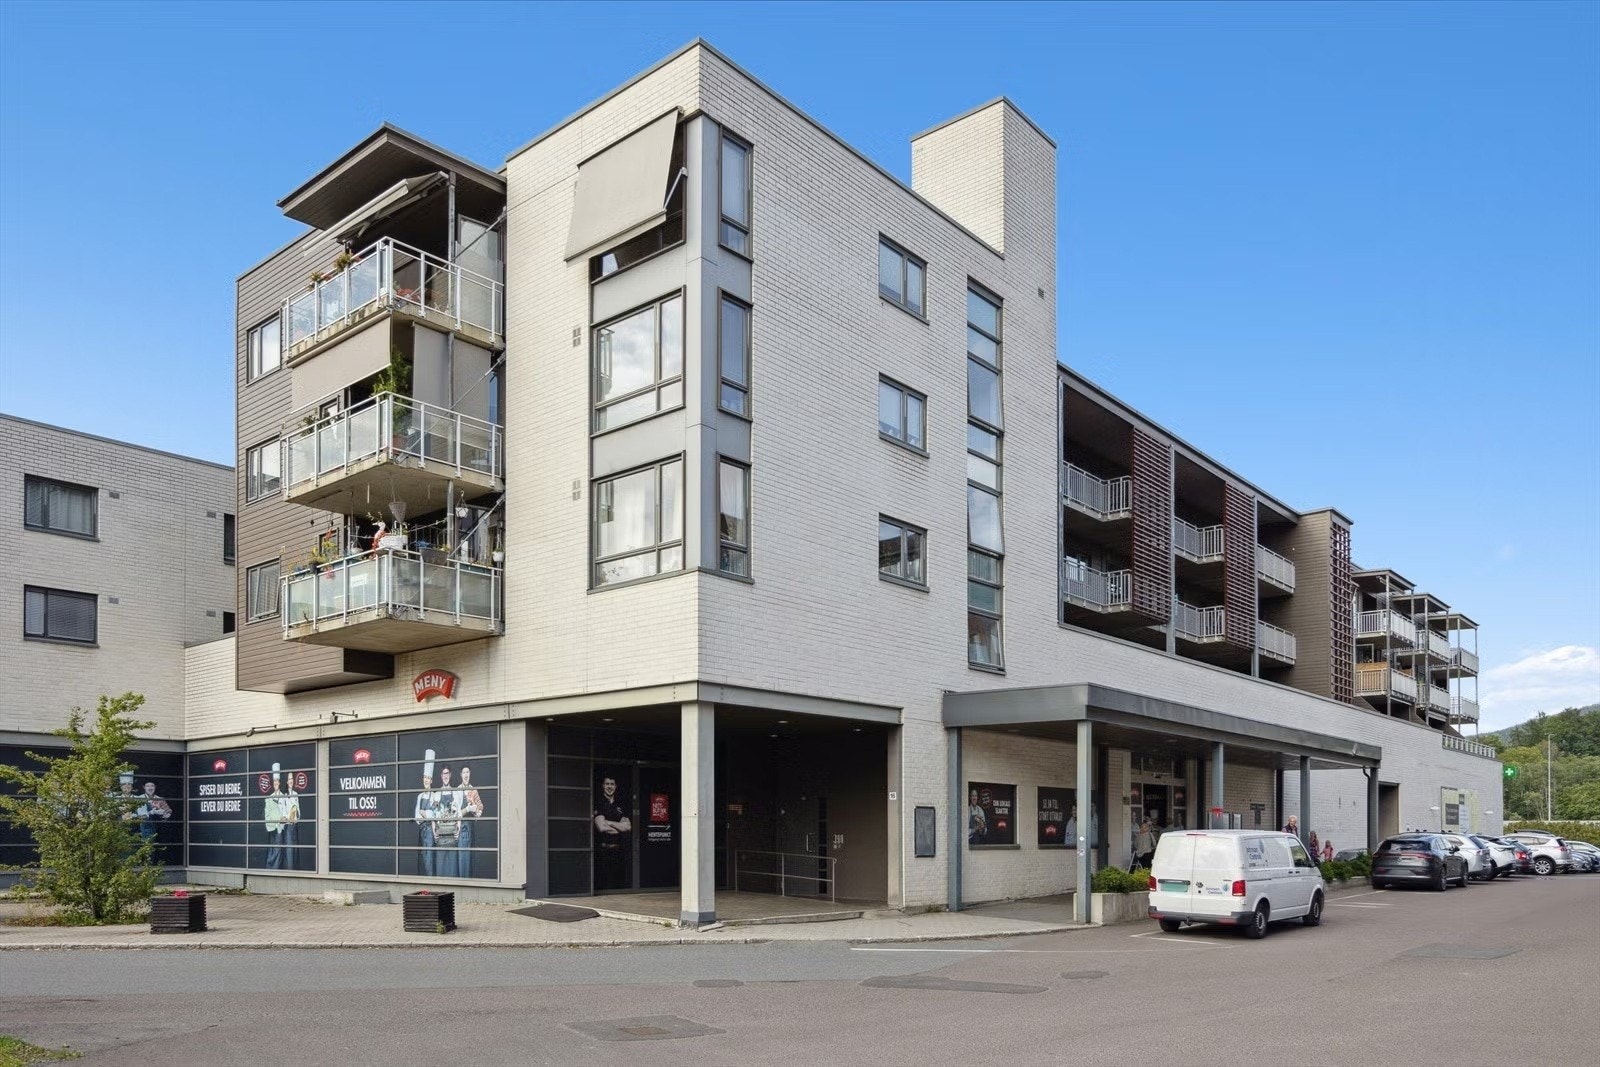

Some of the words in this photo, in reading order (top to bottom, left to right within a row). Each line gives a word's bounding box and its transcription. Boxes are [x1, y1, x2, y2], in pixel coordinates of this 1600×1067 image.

[414, 675, 446, 694] MENY
[199, 784, 216, 796] SPISER
[217, 784, 224, 795] DU
[225, 782, 243, 796] BEDRE,
[340, 775, 387, 790] VELKOMMEN
[201, 801, 216, 812] LEVER
[217, 801, 224, 812] DU
[225, 801, 241, 812] BEDRE
[348, 797, 358, 810] TIL
[359, 797, 377, 810] OSS!
